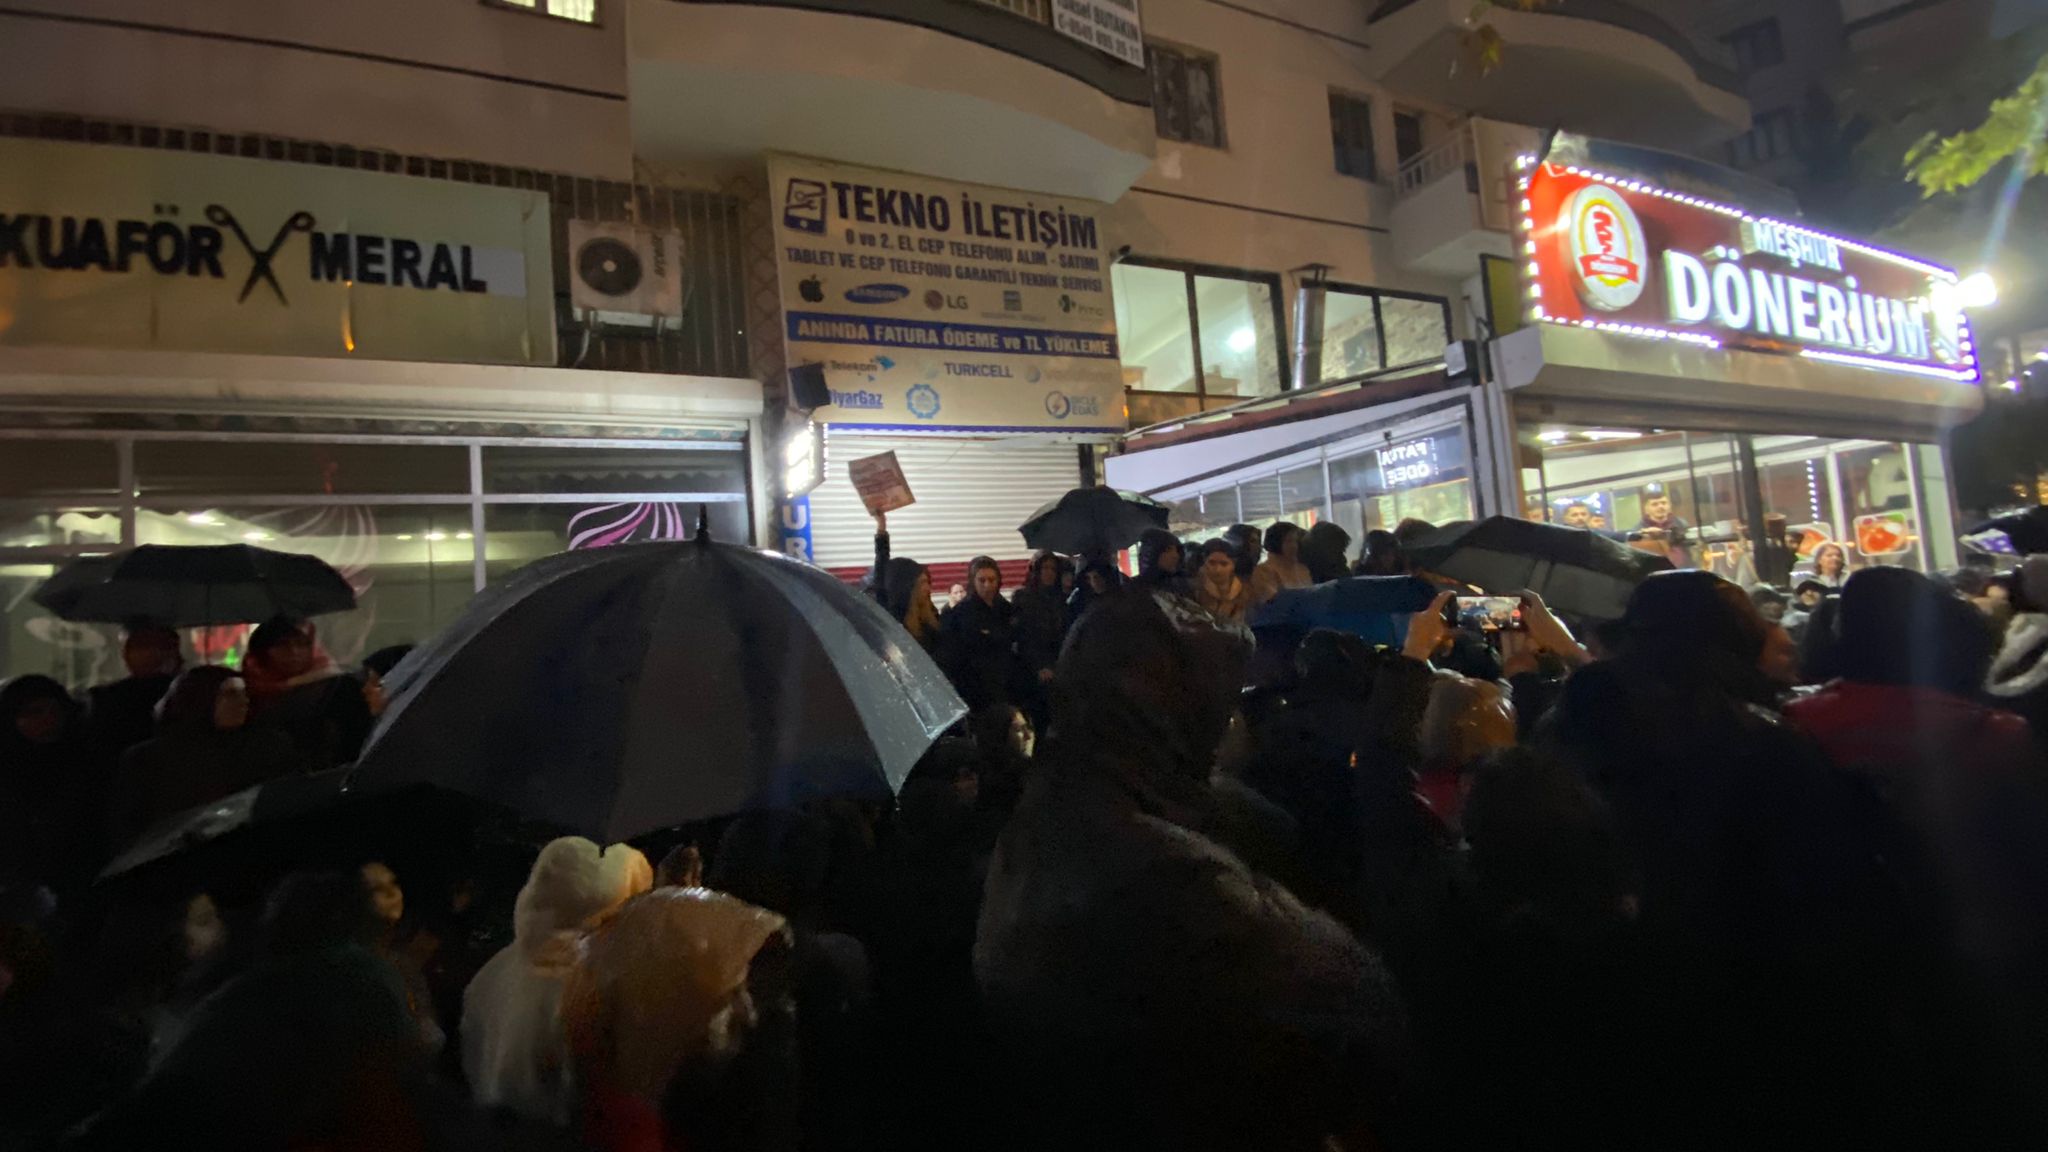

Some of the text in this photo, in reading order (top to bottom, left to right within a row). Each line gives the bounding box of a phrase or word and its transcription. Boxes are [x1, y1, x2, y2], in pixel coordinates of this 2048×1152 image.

[831, 181, 1098, 249] TEKNO İLETİŞİM
[0, 204, 488, 293] KUAFÖR MERAL
[786, 247, 834, 266] TABLET
[838, 252, 856, 269] VE
[860, 255, 885, 271] CEP
[889, 258, 952, 279] TELEFONU
[859, 233, 876, 247] ve
[881, 233, 894, 249] 2.
[898, 235, 914, 252] EL
[918, 238, 944, 255] CEP
[949, 241, 1013, 263] TELEFONU
[1017, 250, 1047, 265] ALIM
[1059, 254, 1099, 271] SATIMI
[1752, 221, 1842, 271] MEŞHUR
[946, 294, 968, 309] LG
[1664, 244, 1930, 360] DÖNERİUM
[798, 319, 1110, 355] ANINDA FATURA ÖDEME ve TL YÜKLEME
[831, 360, 878, 372] Telekom
[944, 362, 1013, 378] TURKCELL
